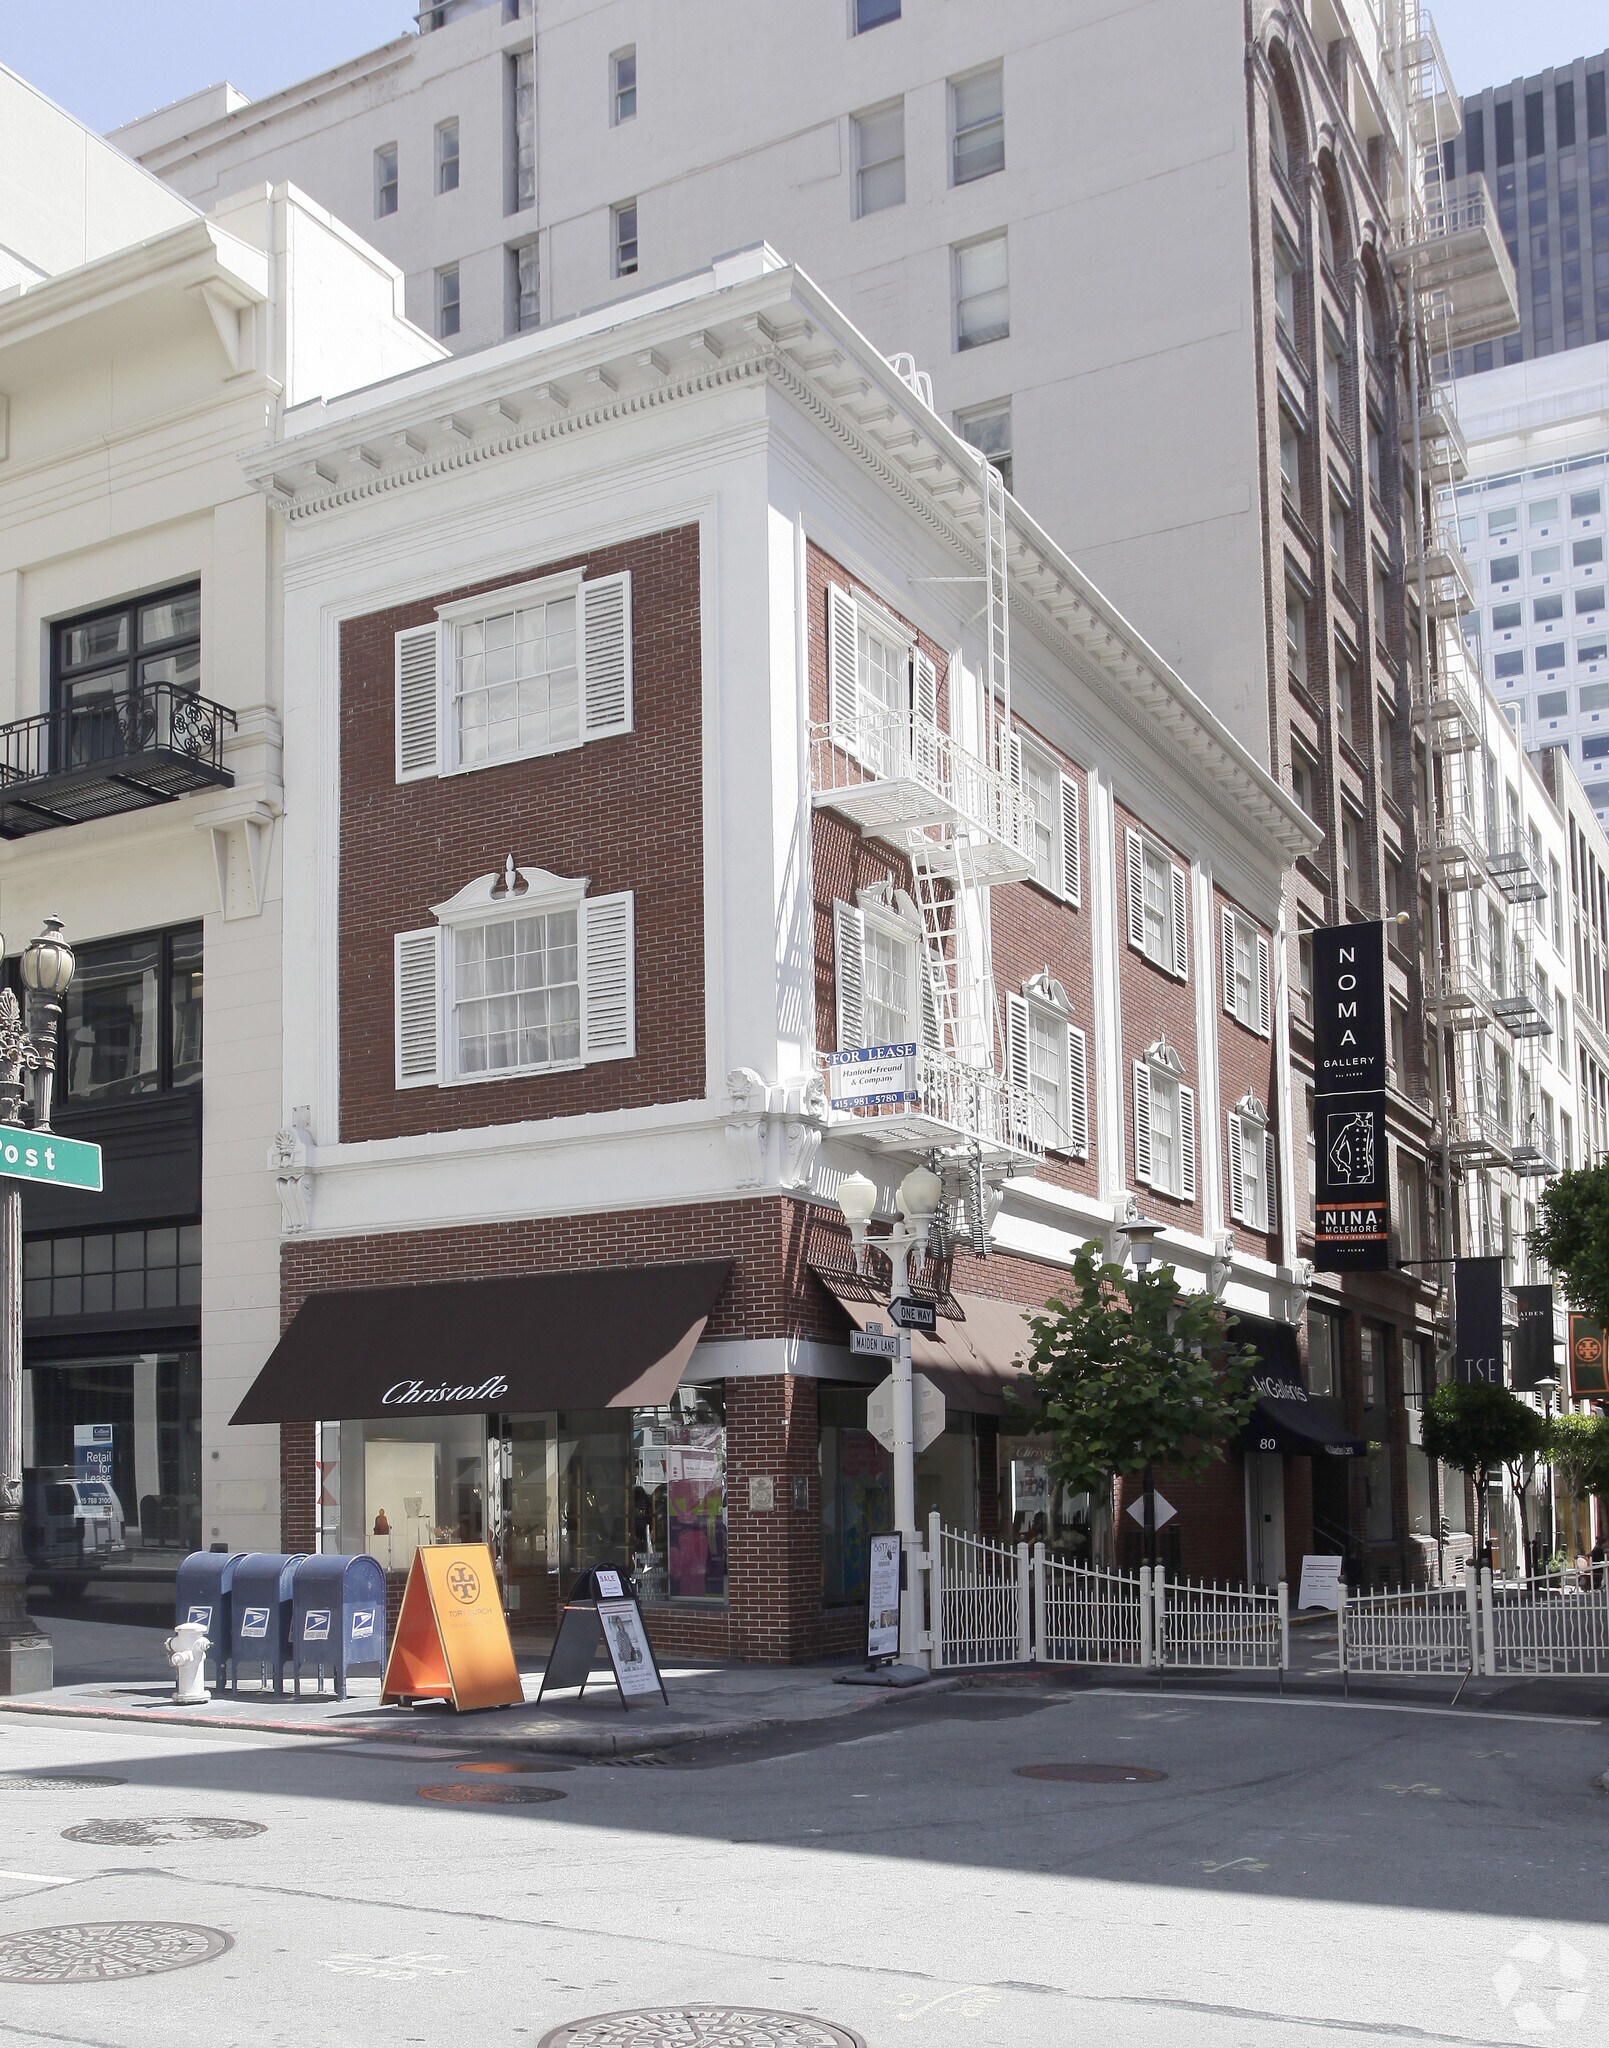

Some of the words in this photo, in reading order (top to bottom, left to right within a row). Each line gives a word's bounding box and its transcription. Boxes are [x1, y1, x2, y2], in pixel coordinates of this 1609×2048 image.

[1338, 947, 1357, 1046] NOMA
[832, 1051, 860, 1065] FOR
[868, 1045, 914, 1060] LEASE
[1323, 1056, 1375, 1068] GALLERY
[859, 1075, 894, 1086] Company
[0, 1141, 55, 1170] ost
[1325, 1210, 1377, 1225] NINA
[1325, 1225, 1378, 1233] MCLEMORE
[901, 1307, 915, 1320] ONE
[917, 1310, 931, 1322] WAY
[873, 1324, 881, 1332] 100
[856, 1336, 877, 1351] MAIDEN
[881, 1340, 895, 1353] LANE
[1464, 1358, 1495, 1383] TSE
[381, 1374, 509, 1404] Christofle
[1260, 1438, 1276, 1450] 80
[86, 1451, 112, 1463] Retail
[99, 1461, 111, 1473] for
[85, 1473, 111, 1483] Lease
[599, 1574, 616, 1582] SALE
[448, 1610, 466, 1618] TOR
